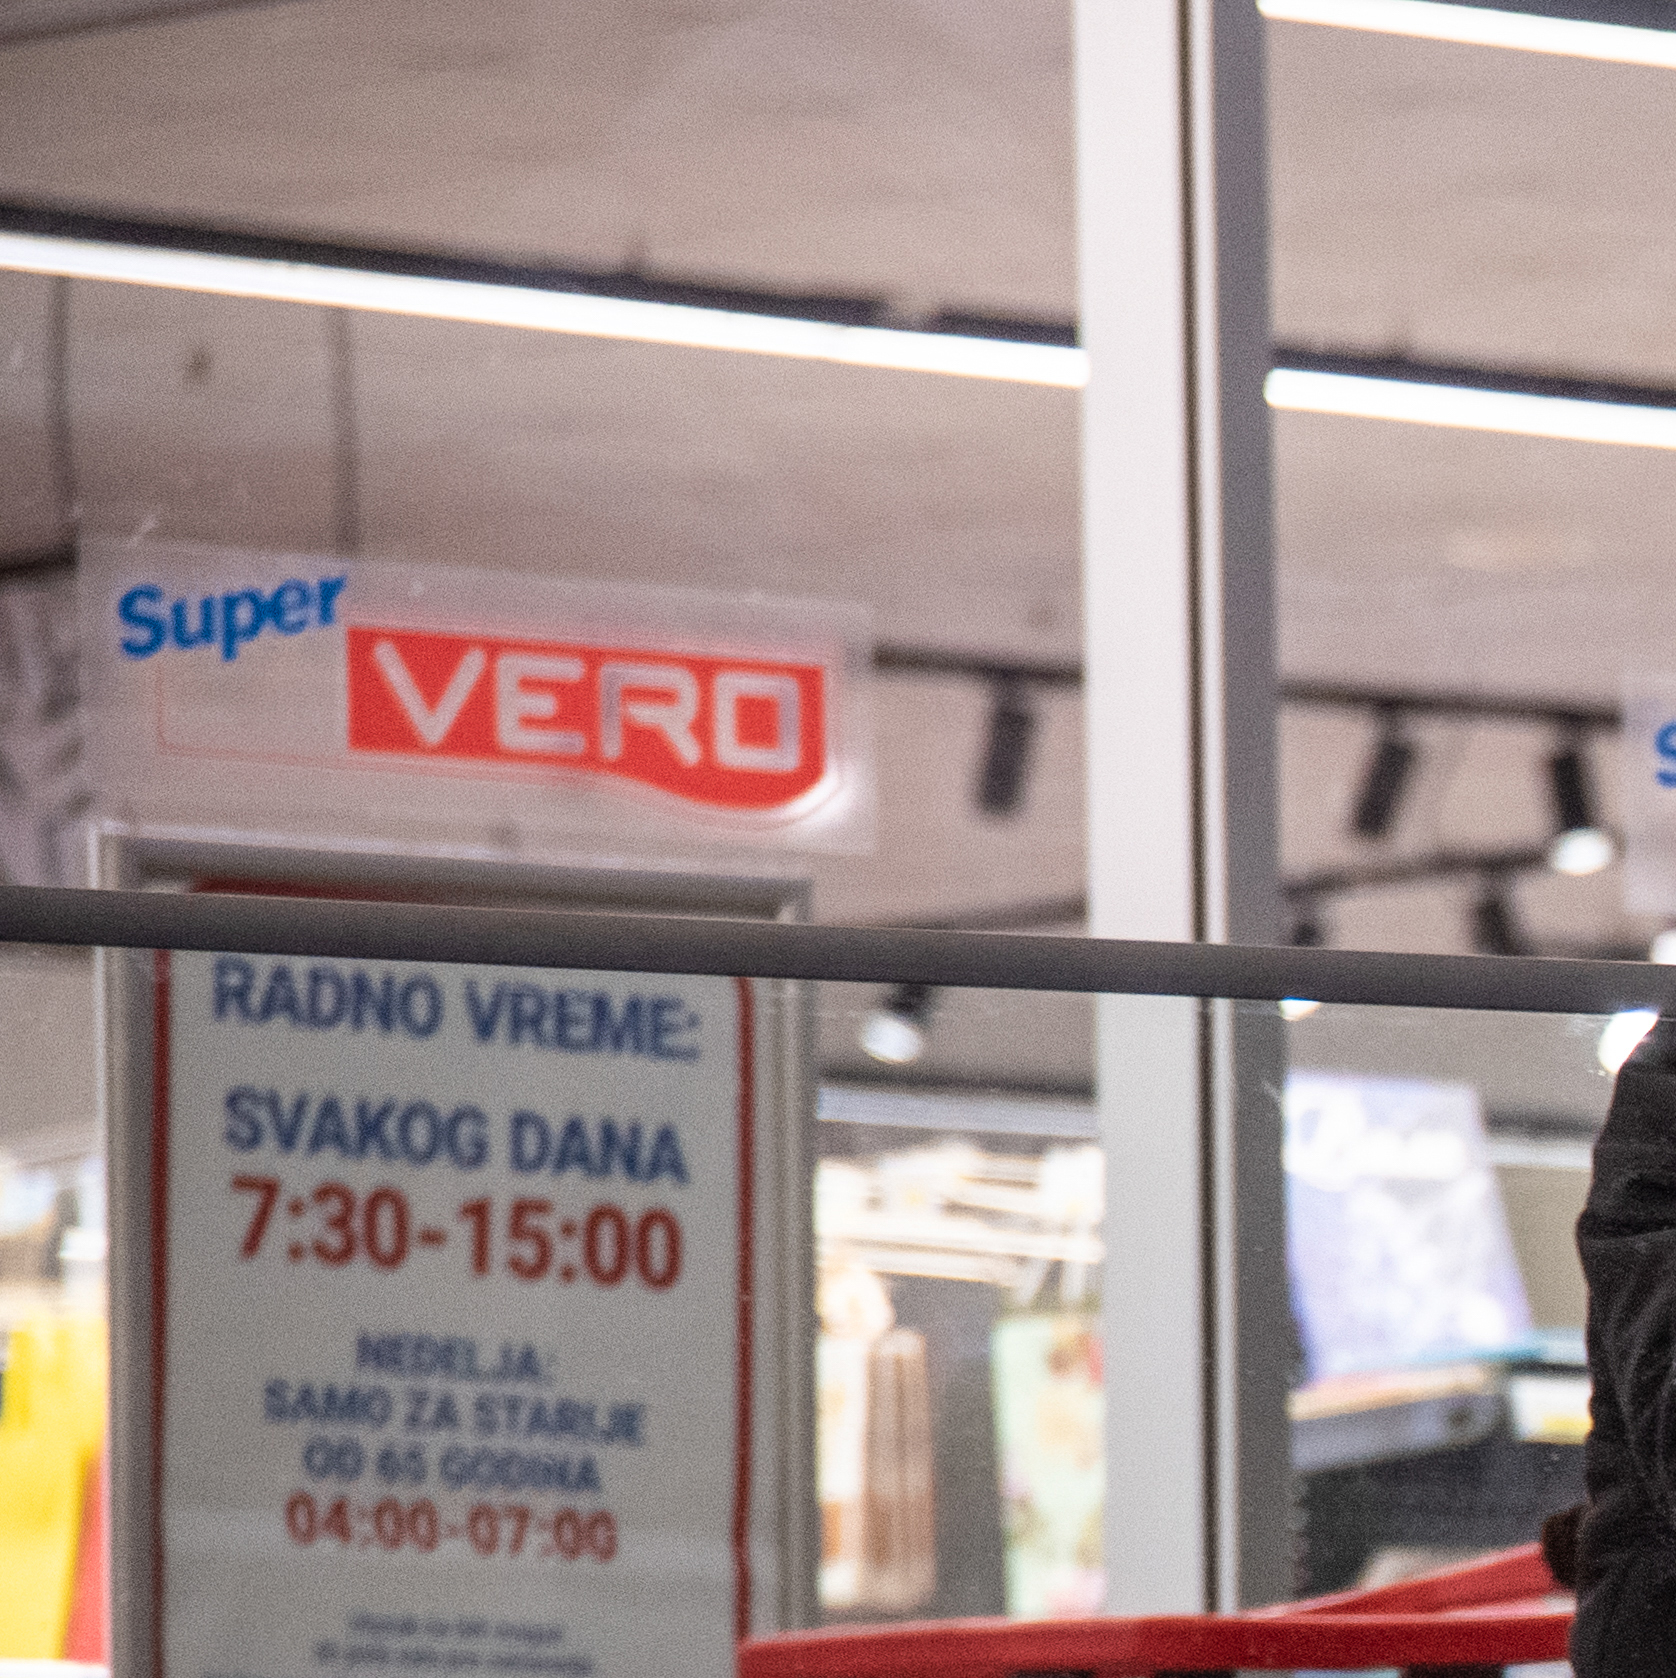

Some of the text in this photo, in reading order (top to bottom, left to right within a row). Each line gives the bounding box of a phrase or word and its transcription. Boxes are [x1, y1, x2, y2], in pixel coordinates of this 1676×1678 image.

[117, 574, 348, 662] Super
[373, 639, 804, 774] VERO
[212, 956, 701, 1061] RADNO VREME:
[224, 1086, 689, 1185] SVAKOG DANA
[232, 1174, 683, 1290] 7:30-15:00
[264, 1379, 392, 1430] SAMO
[404, 1388, 458, 1432] ZA
[302, 1437, 365, 1482] OD
[440, 1447, 602, 1494] GODINA
[284, 1490, 620, 1563] 04:00-07:00
